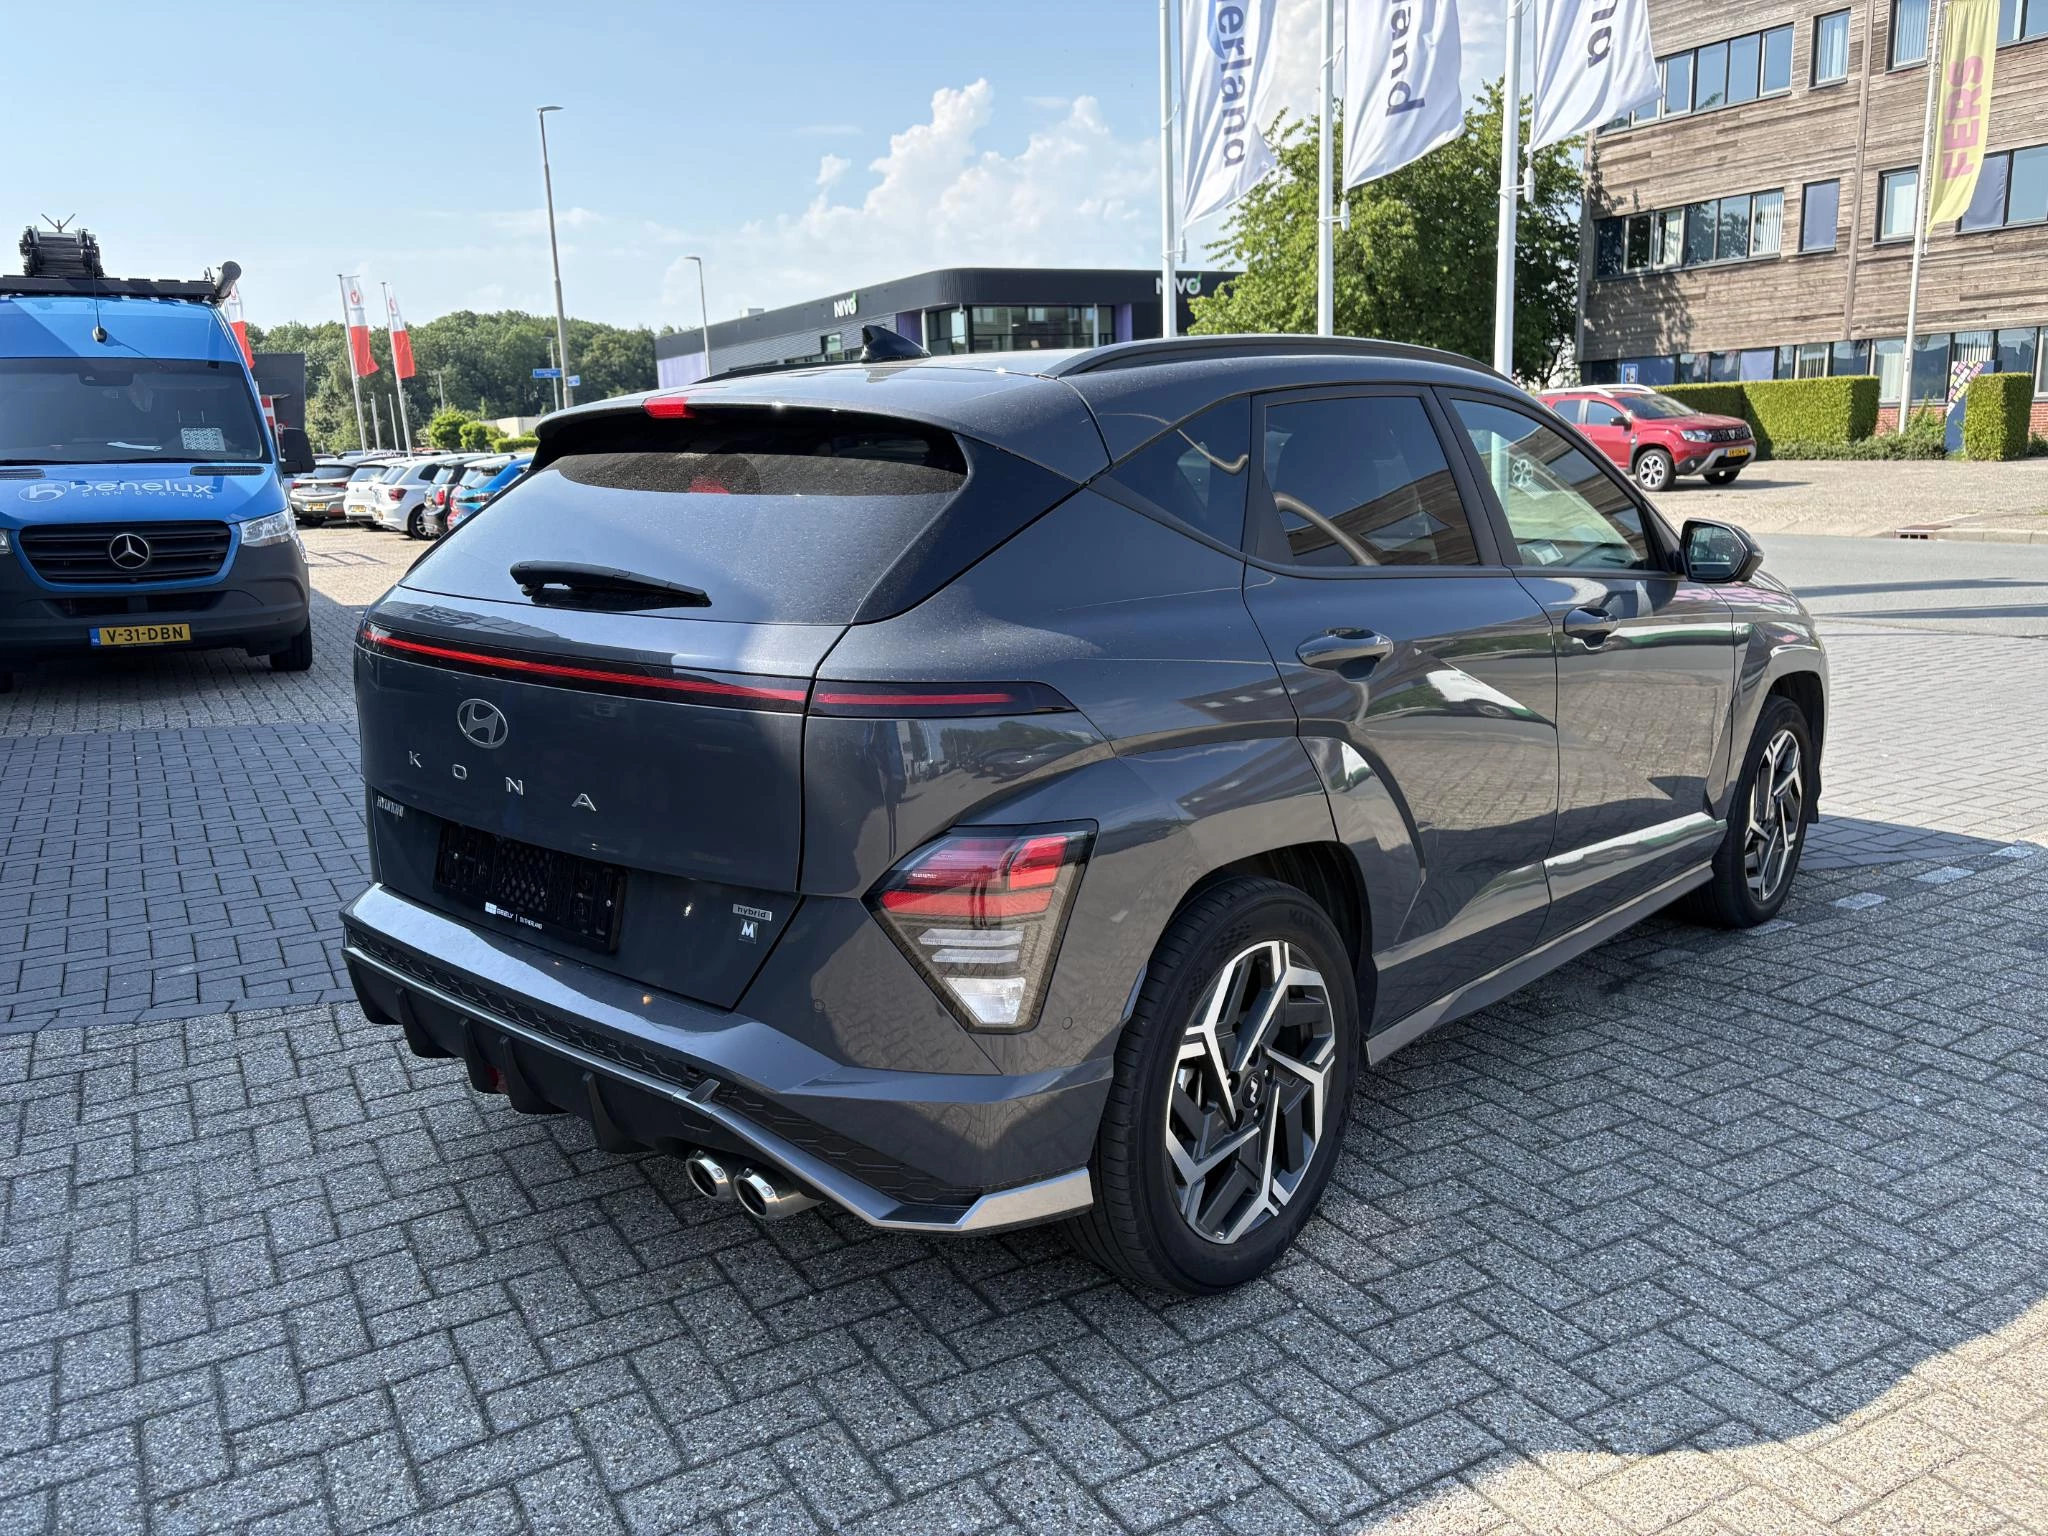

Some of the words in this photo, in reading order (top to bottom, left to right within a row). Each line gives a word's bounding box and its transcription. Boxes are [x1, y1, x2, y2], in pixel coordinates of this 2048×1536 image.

[1385, 0, 1425, 117] and
[1217, 0, 1252, 168] erland
[1942, 55, 1984, 180] FERS
[70, 479, 218, 495] benelux
[135, 490, 216, 500] SYSTEMS
[106, 627, 184, 643] V-31-DBN
[408, 750, 597, 812] KONA
[737, 906, 767, 918] hybrid
[741, 921, 755, 938] M
